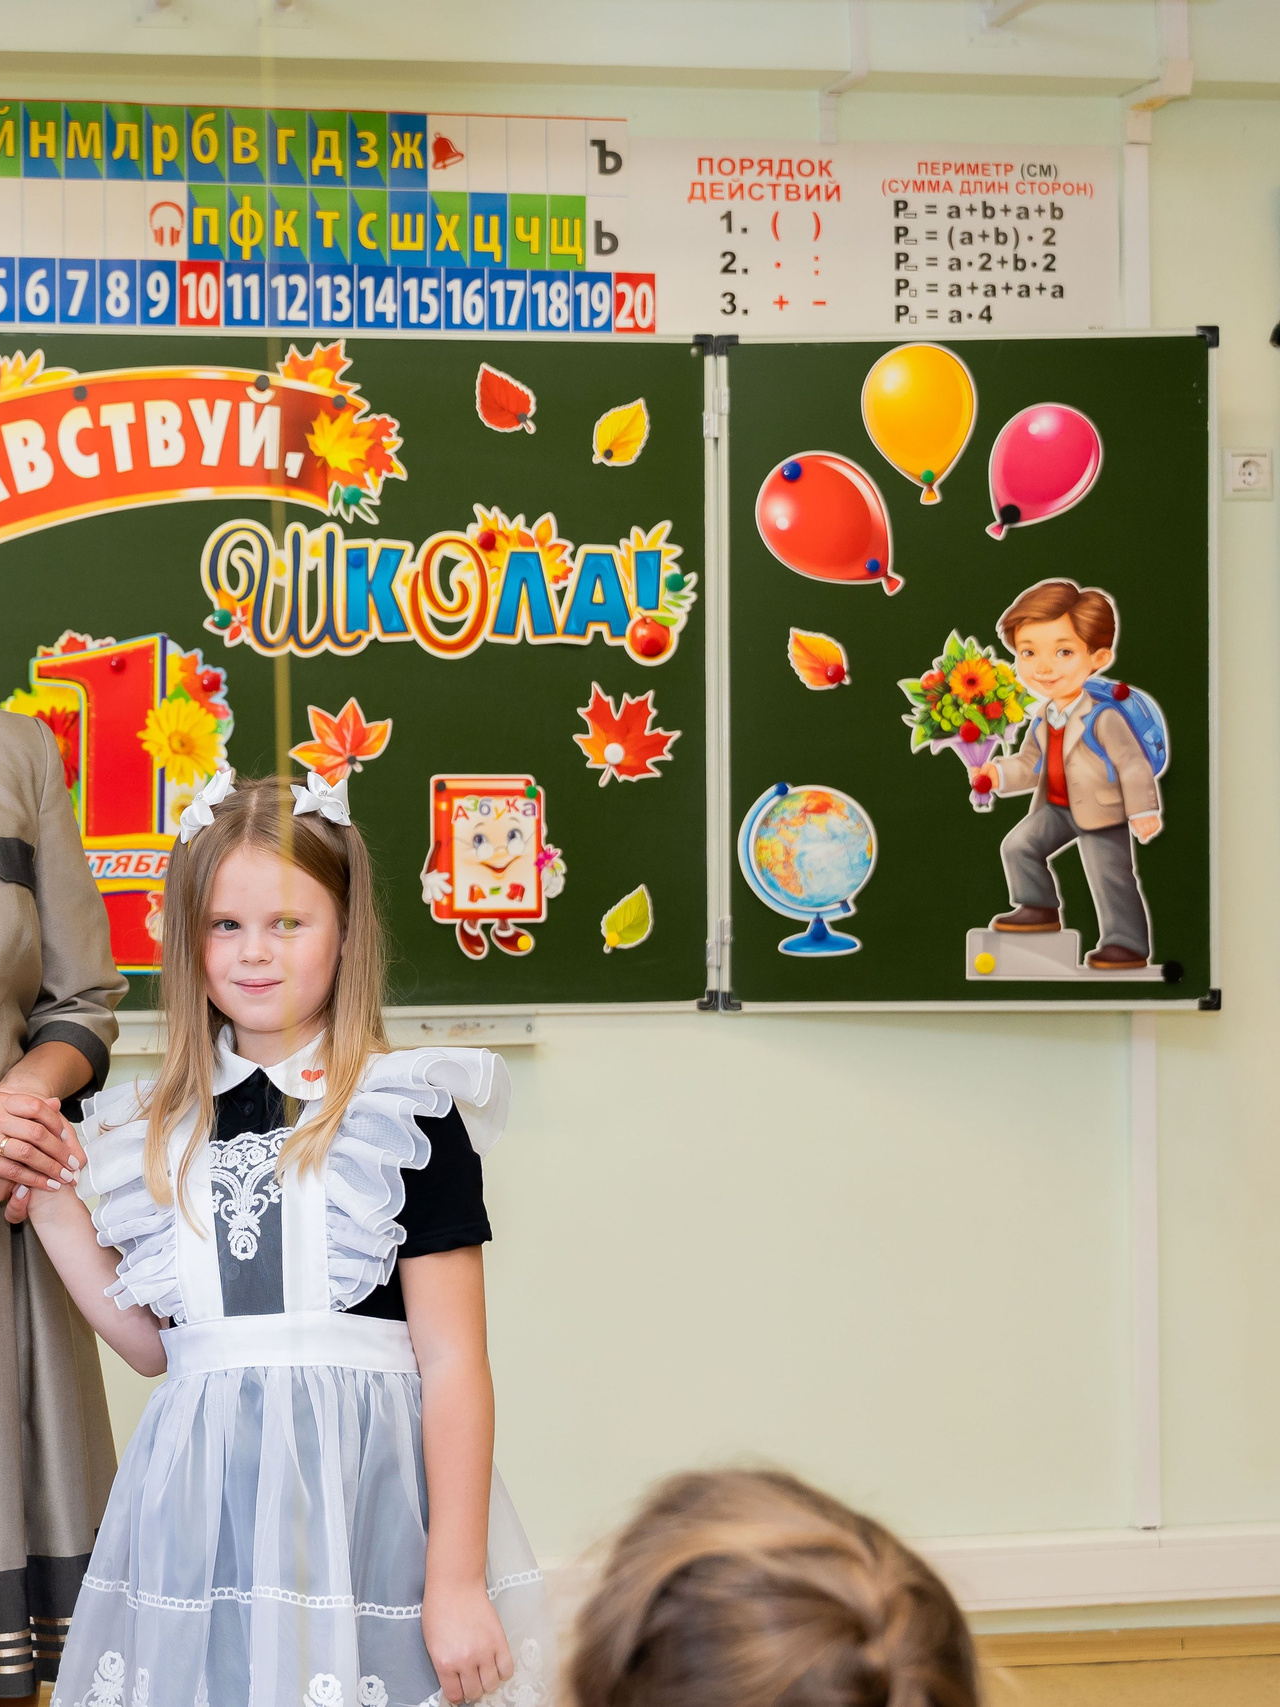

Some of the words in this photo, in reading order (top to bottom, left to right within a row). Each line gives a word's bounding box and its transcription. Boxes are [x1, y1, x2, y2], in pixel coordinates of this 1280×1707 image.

[696, 157, 834, 179] ПОРЯДОК
[917, 161, 1014, 177] ПЕРИМЕТР
[1020, 163, 1058, 179] (СМ)
[687, 180, 842, 203] ДЕЙСТВИЙ
[881, 179, 953, 196] (СУММА
[959, 180, 1008, 197] ДЛИН
[1015, 181, 1094, 198] СТОРОН)
[720, 211, 748, 234] 1.
[720, 251, 749, 275] 2.
[25, 268, 50, 316] 6
[65, 270, 89, 317] 7
[105, 270, 131, 318] 8
[146, 270, 170, 319] 9
[182, 271, 218, 320] 10
[227, 272, 260, 321] 11
[270, 273, 308, 322] 12
[315, 274, 352, 323] 13
[360, 276, 396, 324] 14
[403, 277, 439, 325] 15
[447, 278, 485, 326] 16
[490, 279, 526, 327] 17
[531, 280, 569, 328] 18
[575, 281, 611, 328] 19
[615, 281, 653, 329] 20
[720, 292, 749, 316] 3.
[208, 526, 664, 652] ШКОЛА!
[86, 854, 170, 875] ТЯБР
